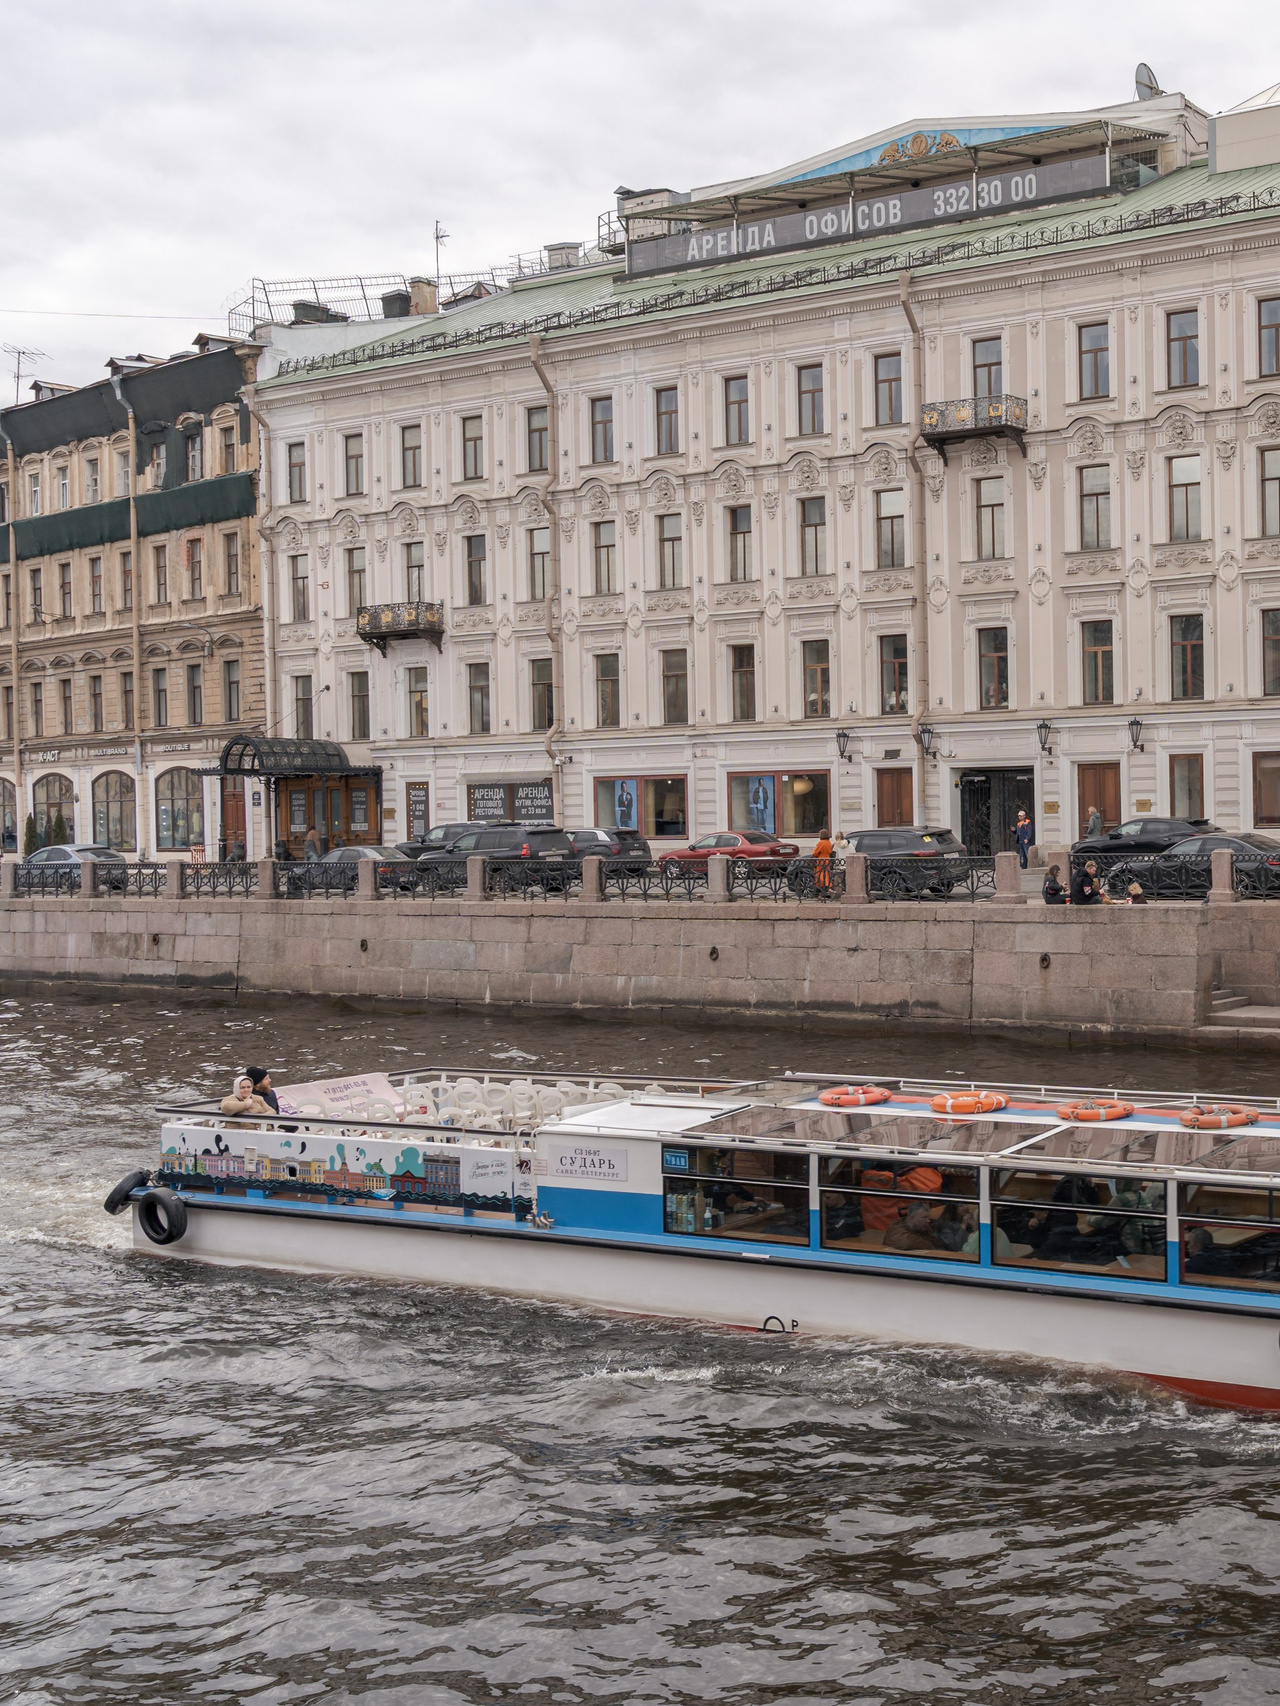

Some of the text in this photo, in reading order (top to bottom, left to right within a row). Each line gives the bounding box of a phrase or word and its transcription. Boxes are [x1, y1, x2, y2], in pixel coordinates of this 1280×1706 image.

[687, 173, 1037, 261] АРЕНДА ОФИСОВ 332 30 00
[474, 788, 505, 800] АРЕНДА
[517, 786, 550, 799] АРЕНДА
[476, 800, 503, 808] ГОТОВОГО
[515, 799, 552, 807] БУТИК-ОФИСА
[475, 808, 504, 816] РЕСТОРАНА
[559, 1155, 616, 1170] СУДАРЬ
[671, 1156, 686, 1166] BAR
[555, 1168, 620, 1178] САНКТ-ПЕТЕРБУРГ
